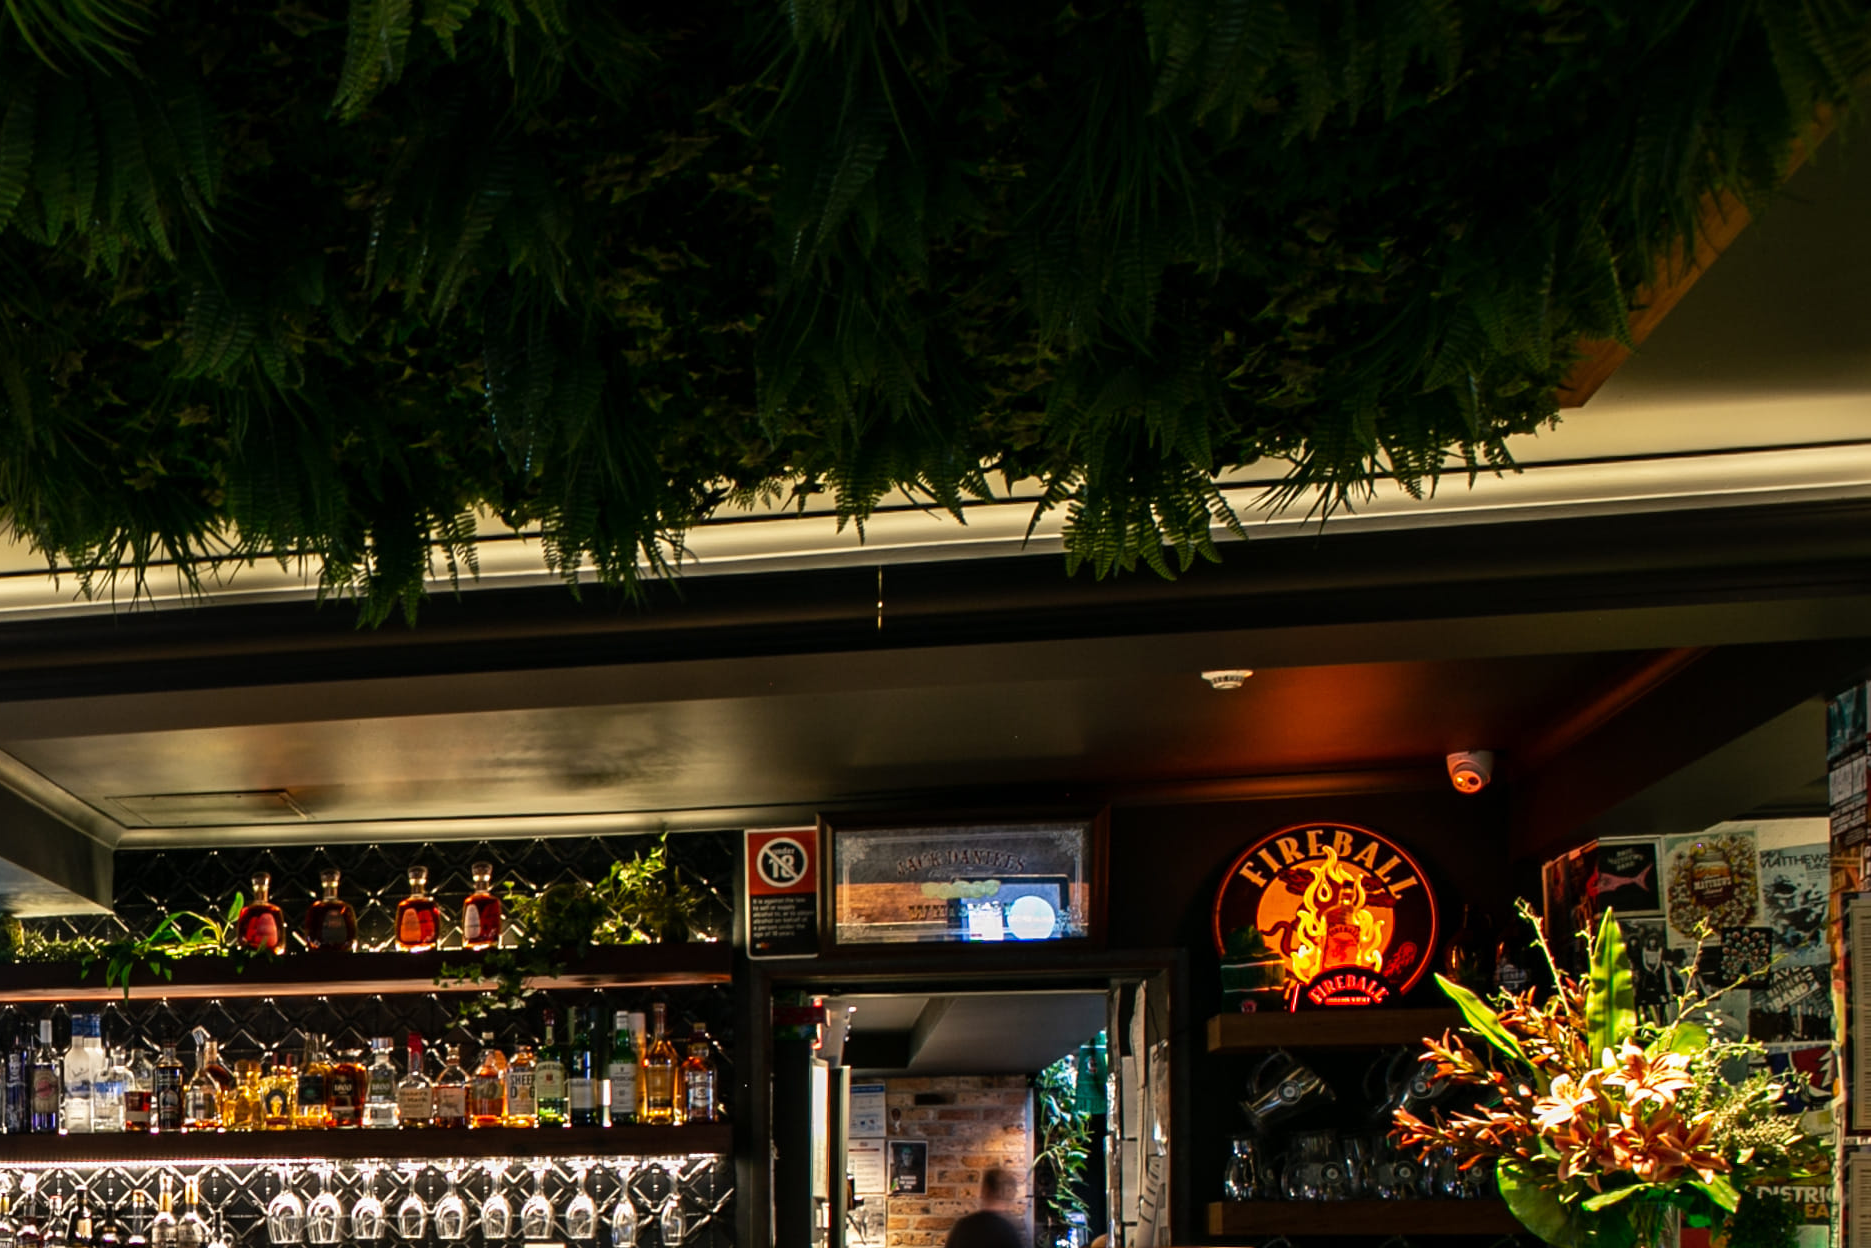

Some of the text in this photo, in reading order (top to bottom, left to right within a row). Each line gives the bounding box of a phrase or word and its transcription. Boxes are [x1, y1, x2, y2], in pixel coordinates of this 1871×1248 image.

[769, 855, 795, 878] 18
[1239, 829, 1419, 900] FIREBALL
[1308, 974, 1389, 1005] FIREBALL
